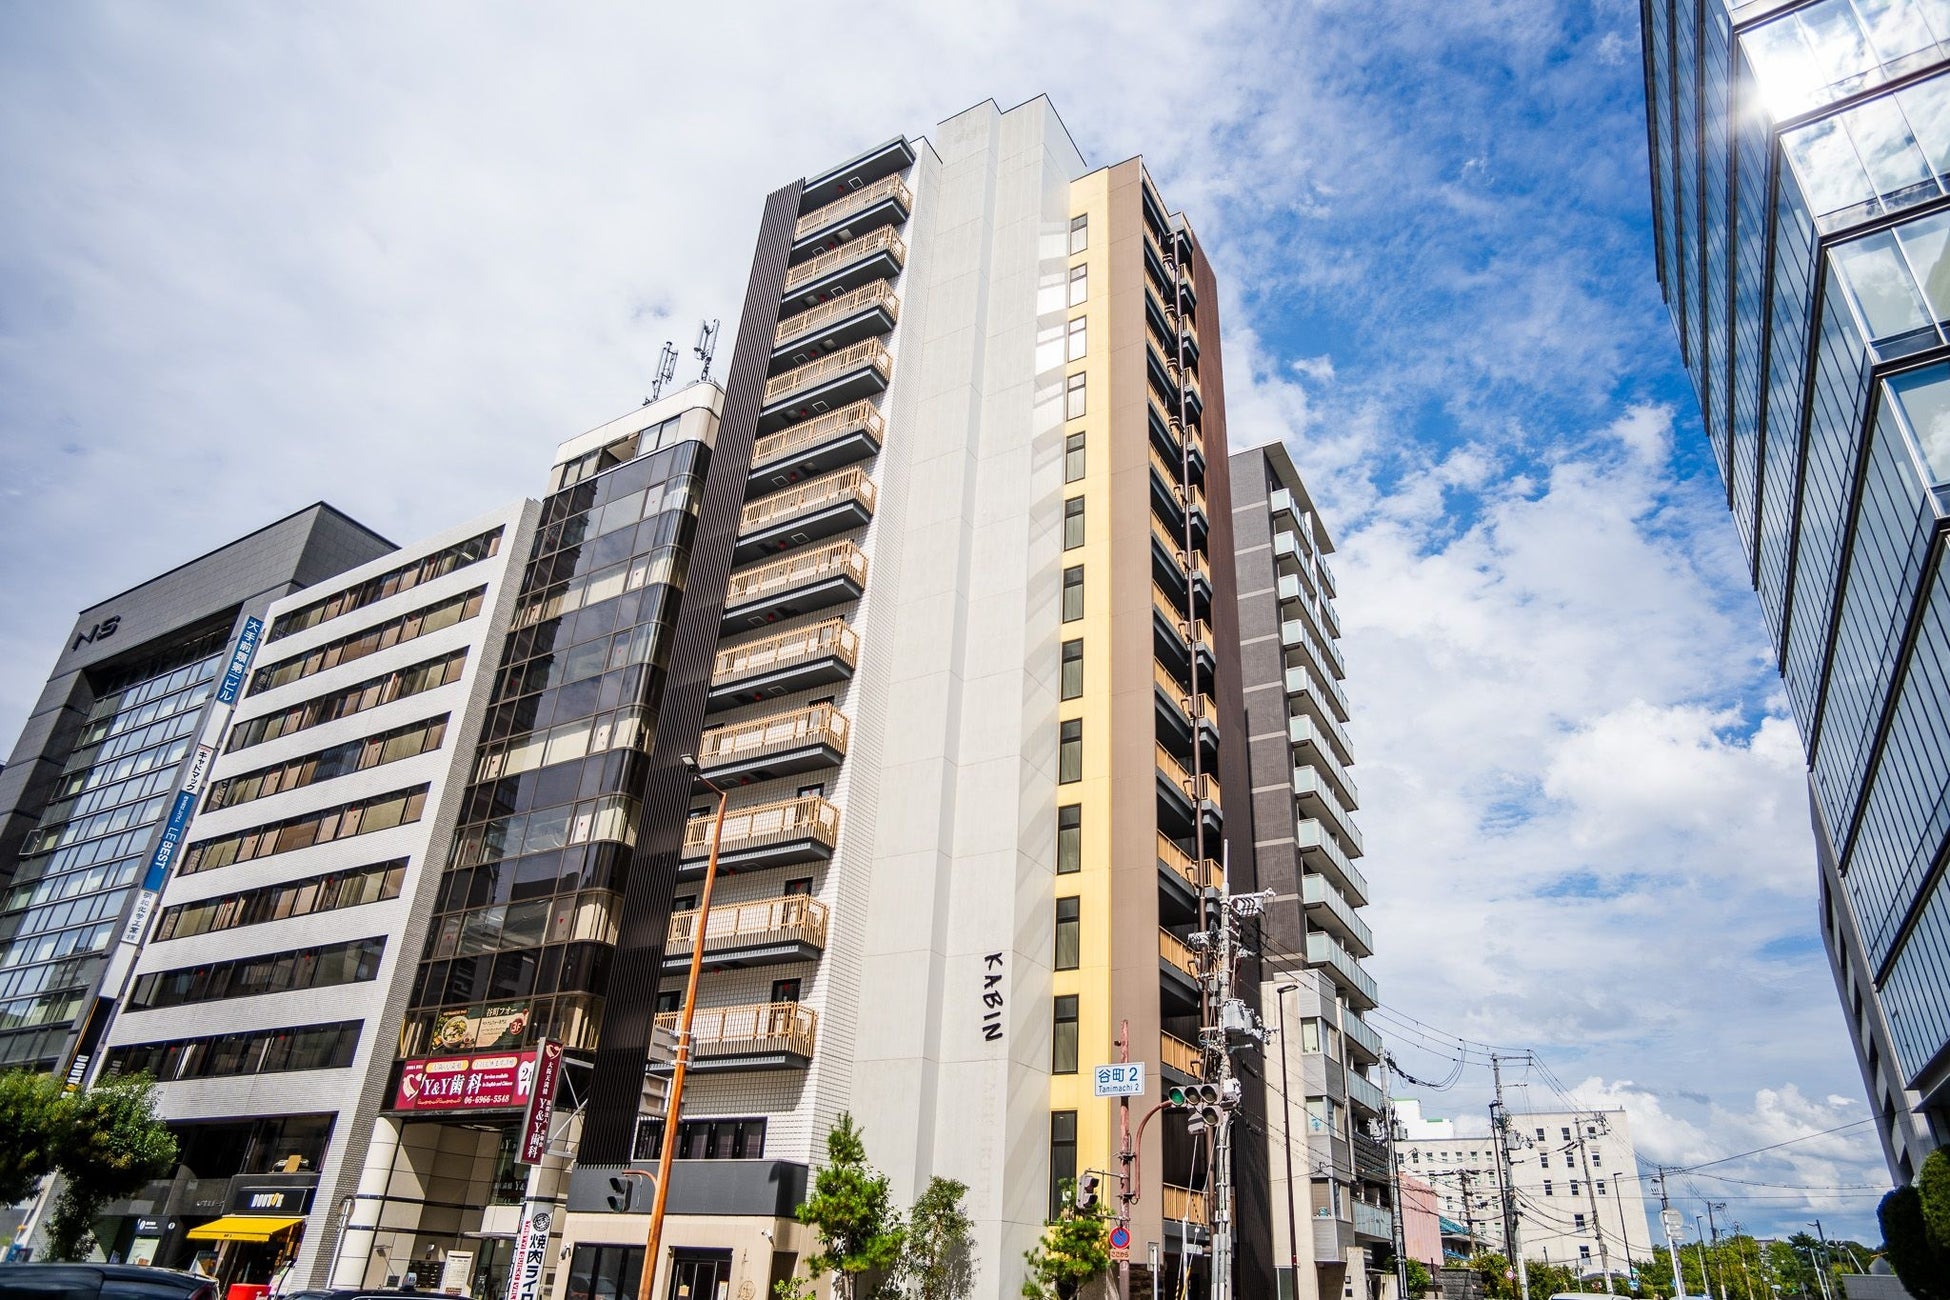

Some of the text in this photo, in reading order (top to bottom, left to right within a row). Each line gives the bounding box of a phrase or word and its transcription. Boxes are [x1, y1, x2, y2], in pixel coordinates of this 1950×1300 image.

[72, 615, 121, 652] NS
[982, 952, 1004, 1042] KABIN
[511, 1021, 522, 1032] 3F
[1098, 1083, 1140, 1093] Tanimachi 2
